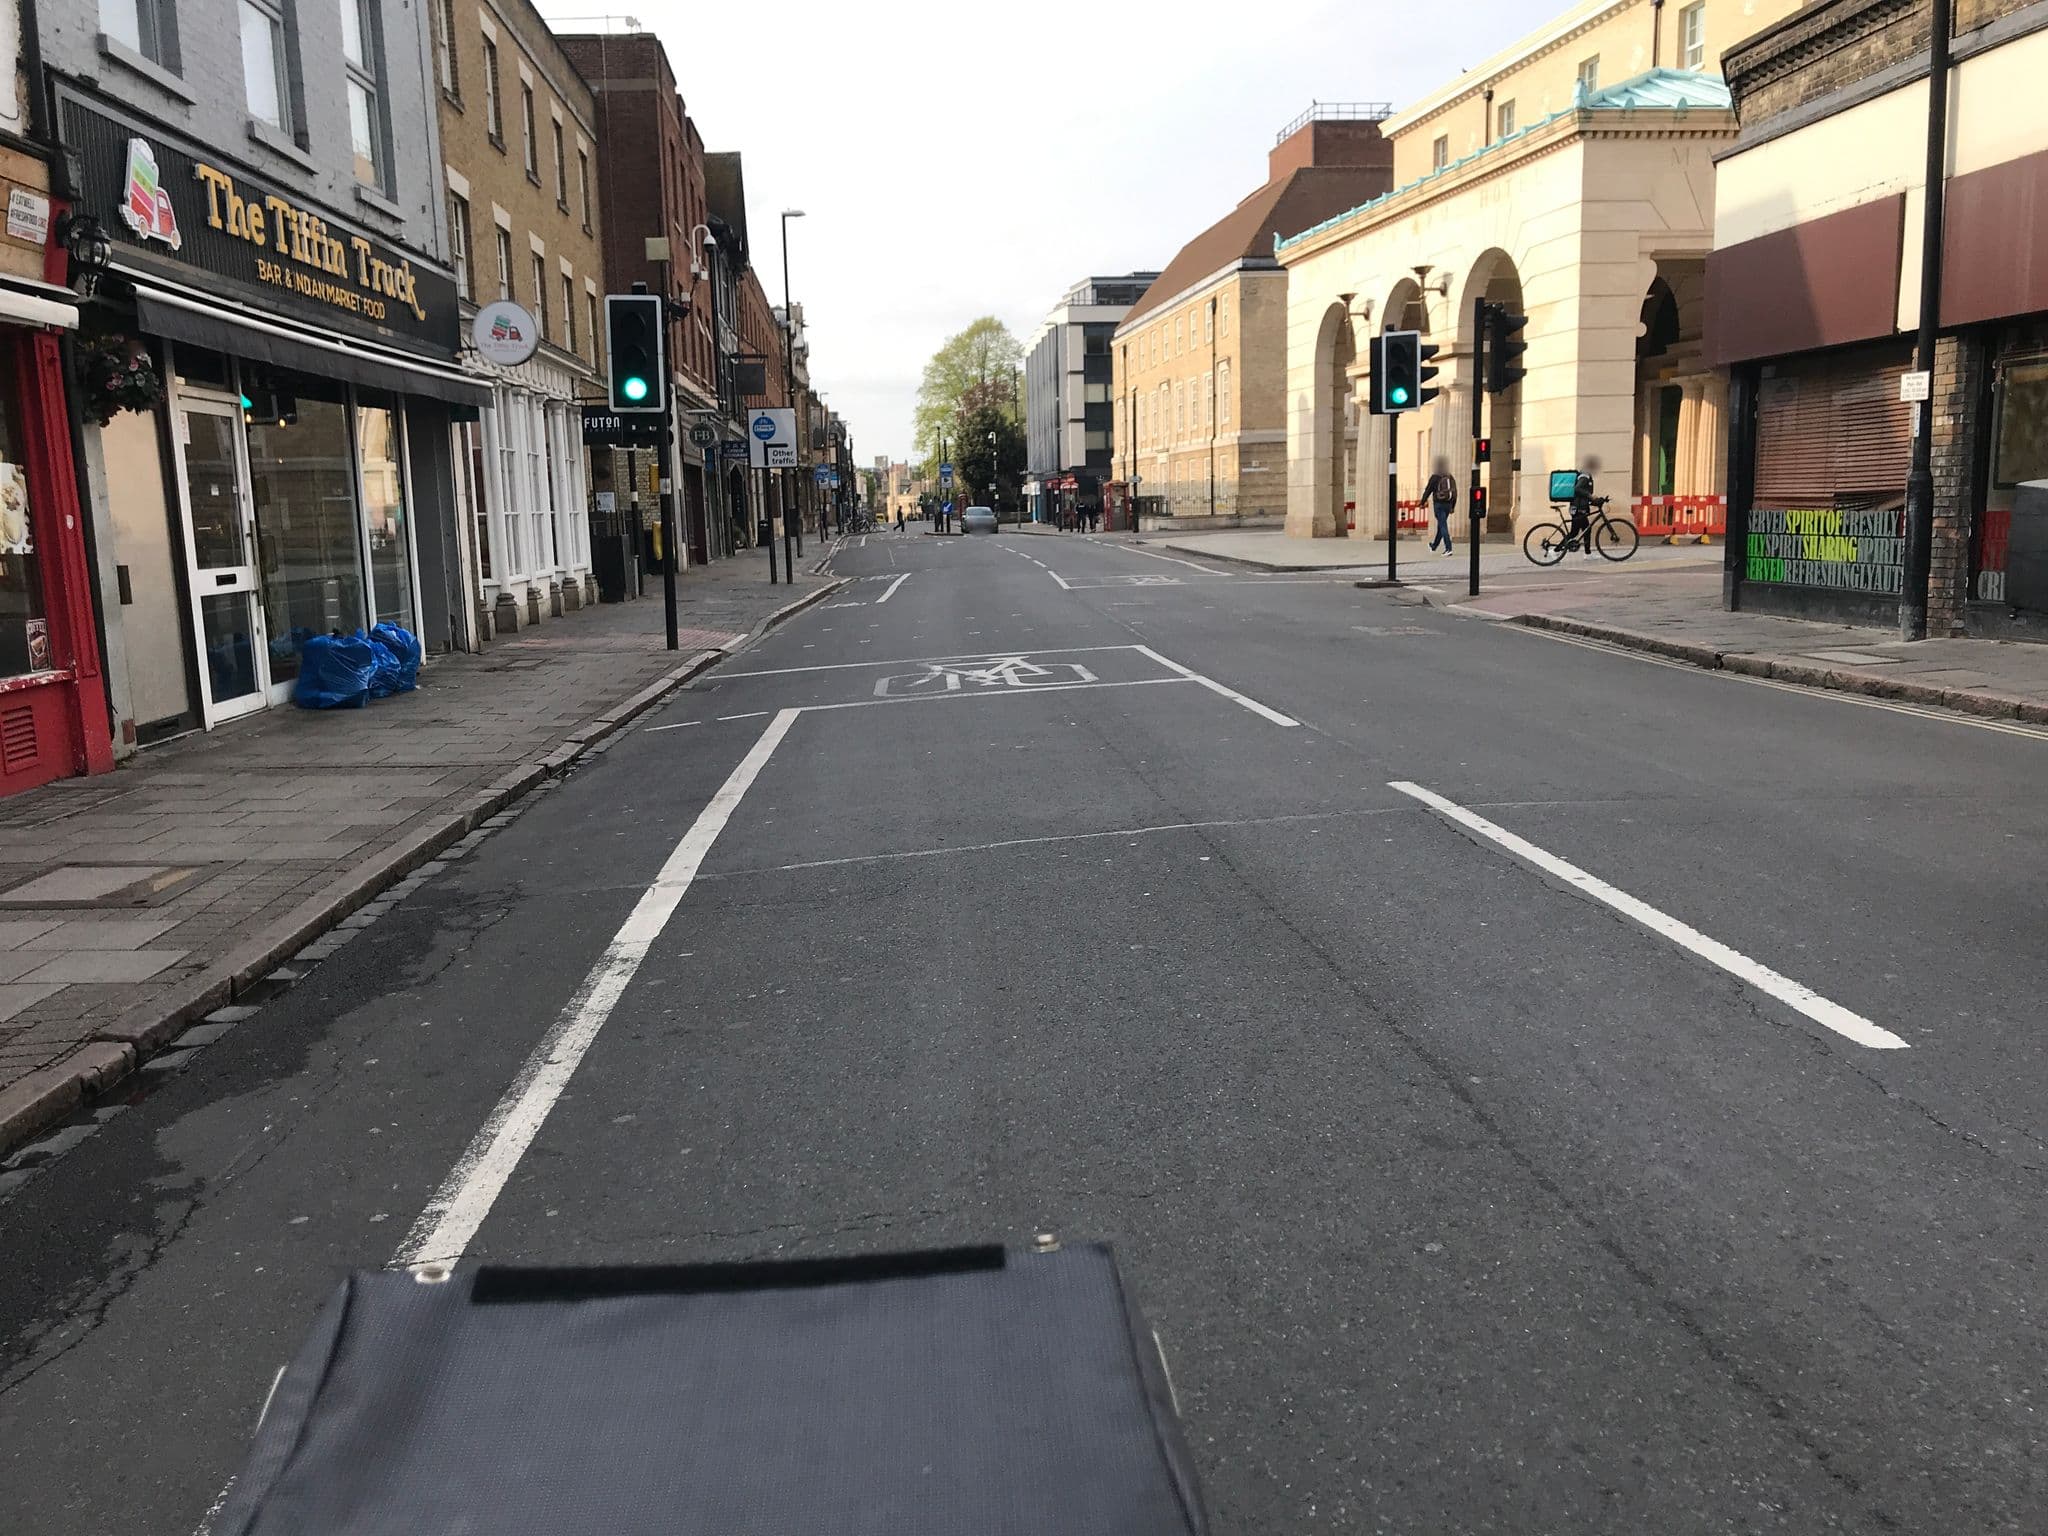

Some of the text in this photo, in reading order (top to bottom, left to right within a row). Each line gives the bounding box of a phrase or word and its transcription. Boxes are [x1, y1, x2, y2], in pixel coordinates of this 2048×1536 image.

[196, 163, 426, 321] The Tiffin Truck
[257, 258, 283, 286] BAR
[285, 267, 293, 289] &
[325, 283, 360, 313] MARKET
[362, 297, 386, 320] FOOD
[584, 416, 620, 429] FUTON
[772, 449, 794, 457] Other
[772, 457, 796, 465] traffic
